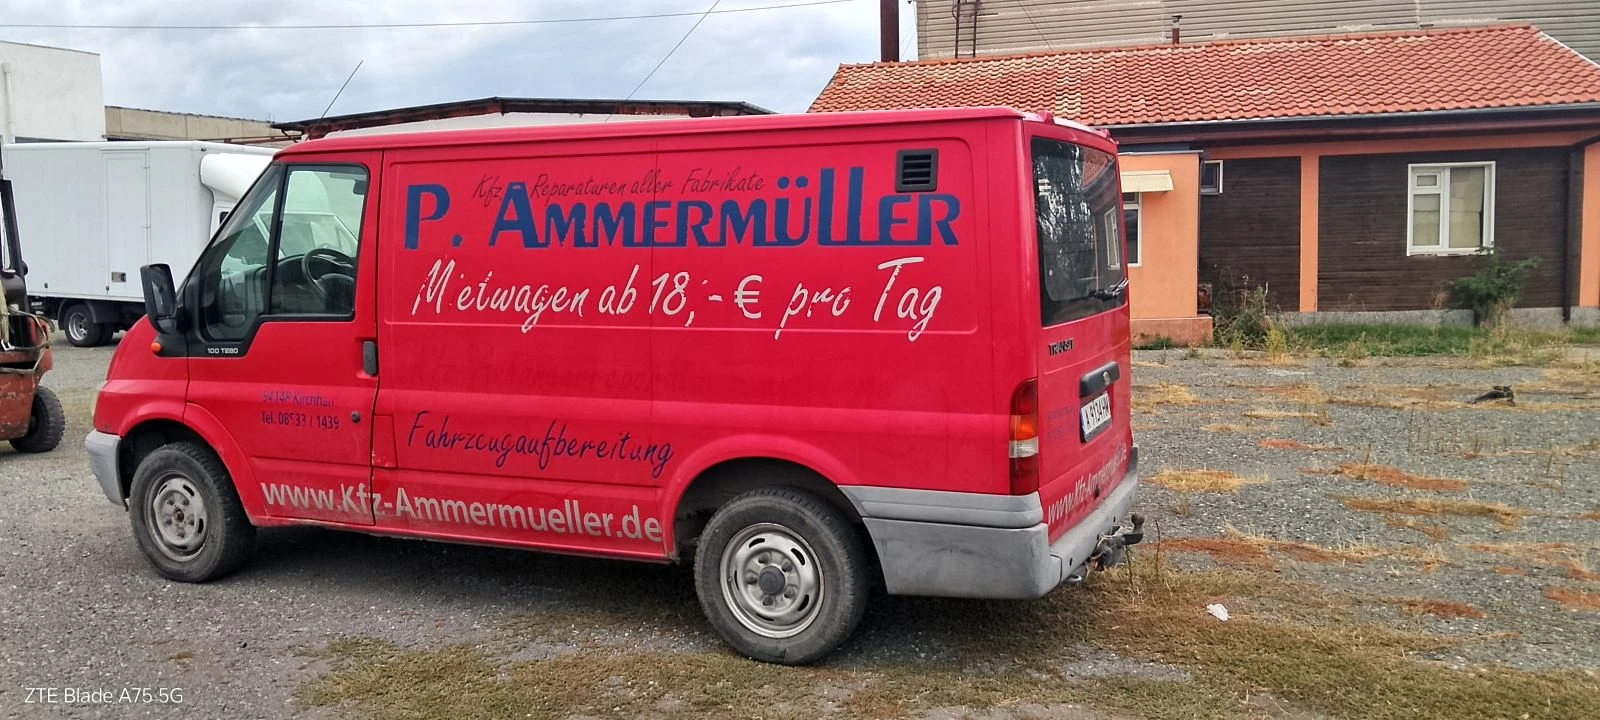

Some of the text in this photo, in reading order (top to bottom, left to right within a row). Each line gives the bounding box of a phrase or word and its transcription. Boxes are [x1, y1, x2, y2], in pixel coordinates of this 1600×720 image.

[404, 184, 464, 250] P.
[531, 173, 625, 207] Reparaturen
[631, 169, 673, 195] aller
[681, 167, 765, 195] Fabrikate
[598, 264, 640, 315] ab
[734, 274, 763, 319] €
[774, 282, 851, 340] pro
[873, 256, 943, 342] Tag
[262, 411, 276, 424] Tel.
[316, 415, 340, 430] 1439
[260, 482, 663, 542] www.Kfz-Ammermueller.de
